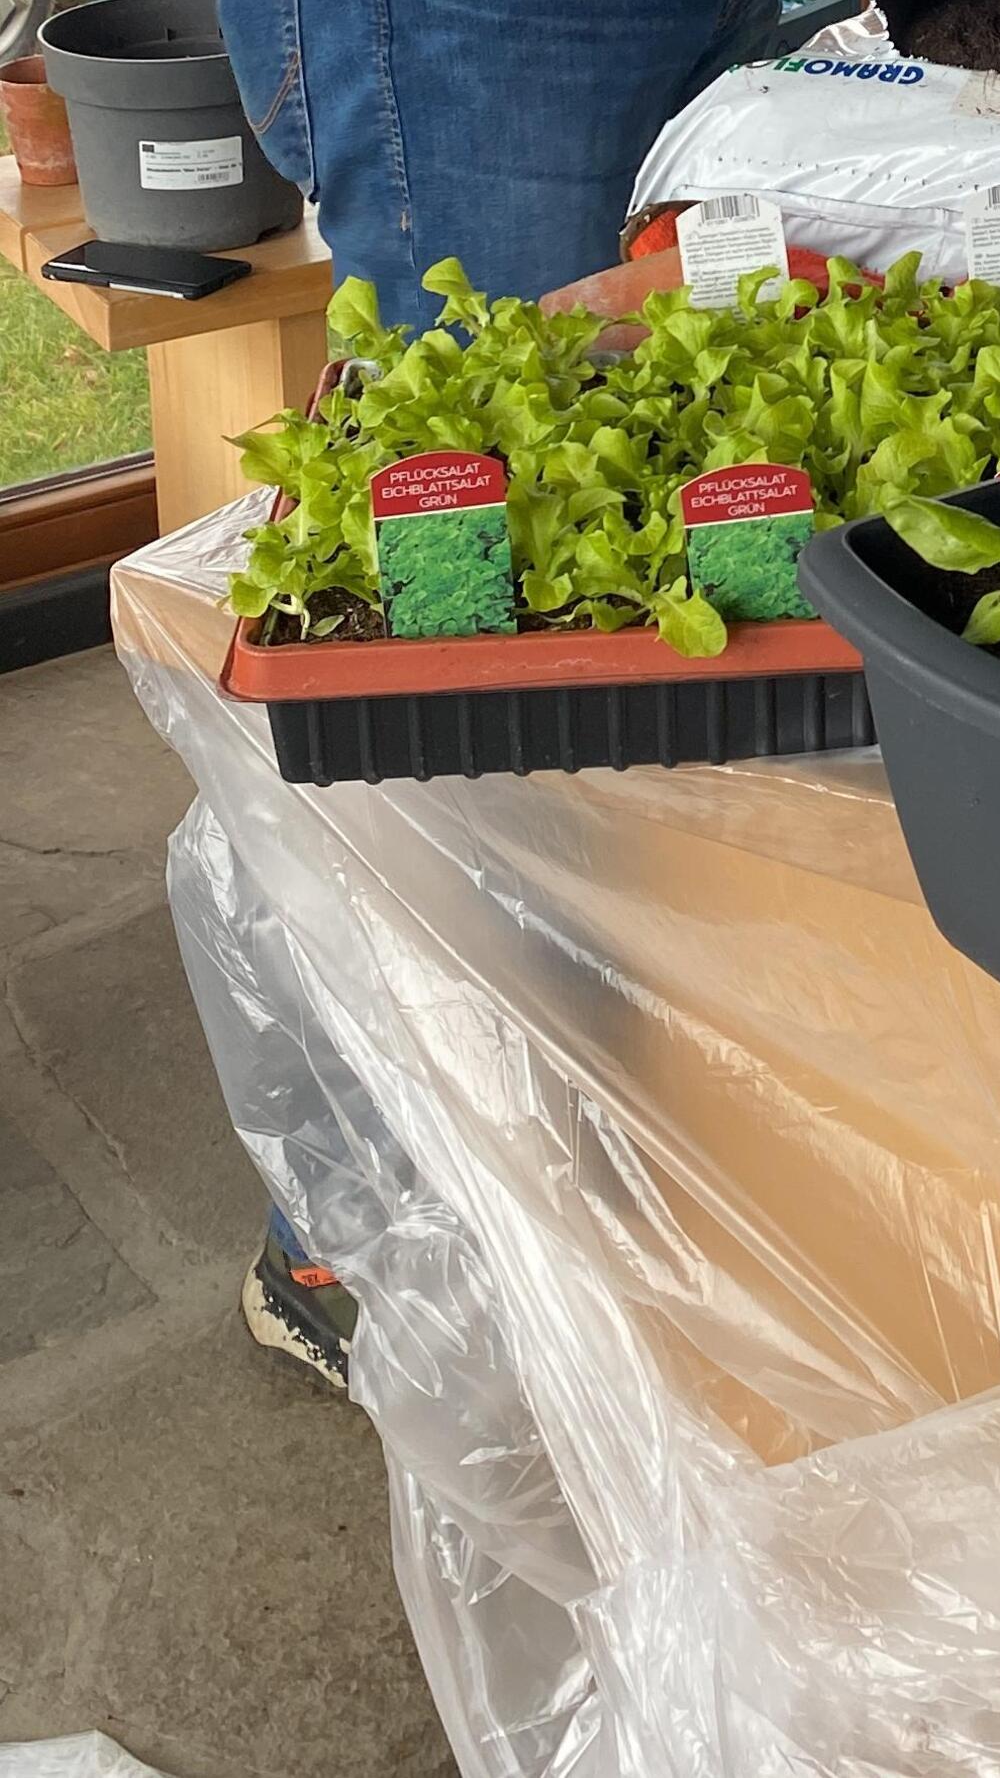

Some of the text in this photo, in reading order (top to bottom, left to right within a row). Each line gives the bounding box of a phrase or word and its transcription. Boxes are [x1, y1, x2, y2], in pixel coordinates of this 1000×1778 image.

[728, 57, 924, 85] GRAMOFL
[389, 462, 480, 484] PFLÜCKSALAT
[698, 473, 787, 494] PFLÜCKSALAT
[381, 475, 491, 499] EICHBLATTSALAT
[690, 484, 798, 508] EICHBLATTSALAT
[419, 494, 457, 508] GRÜN
[727, 502, 765, 516] GRÜN
